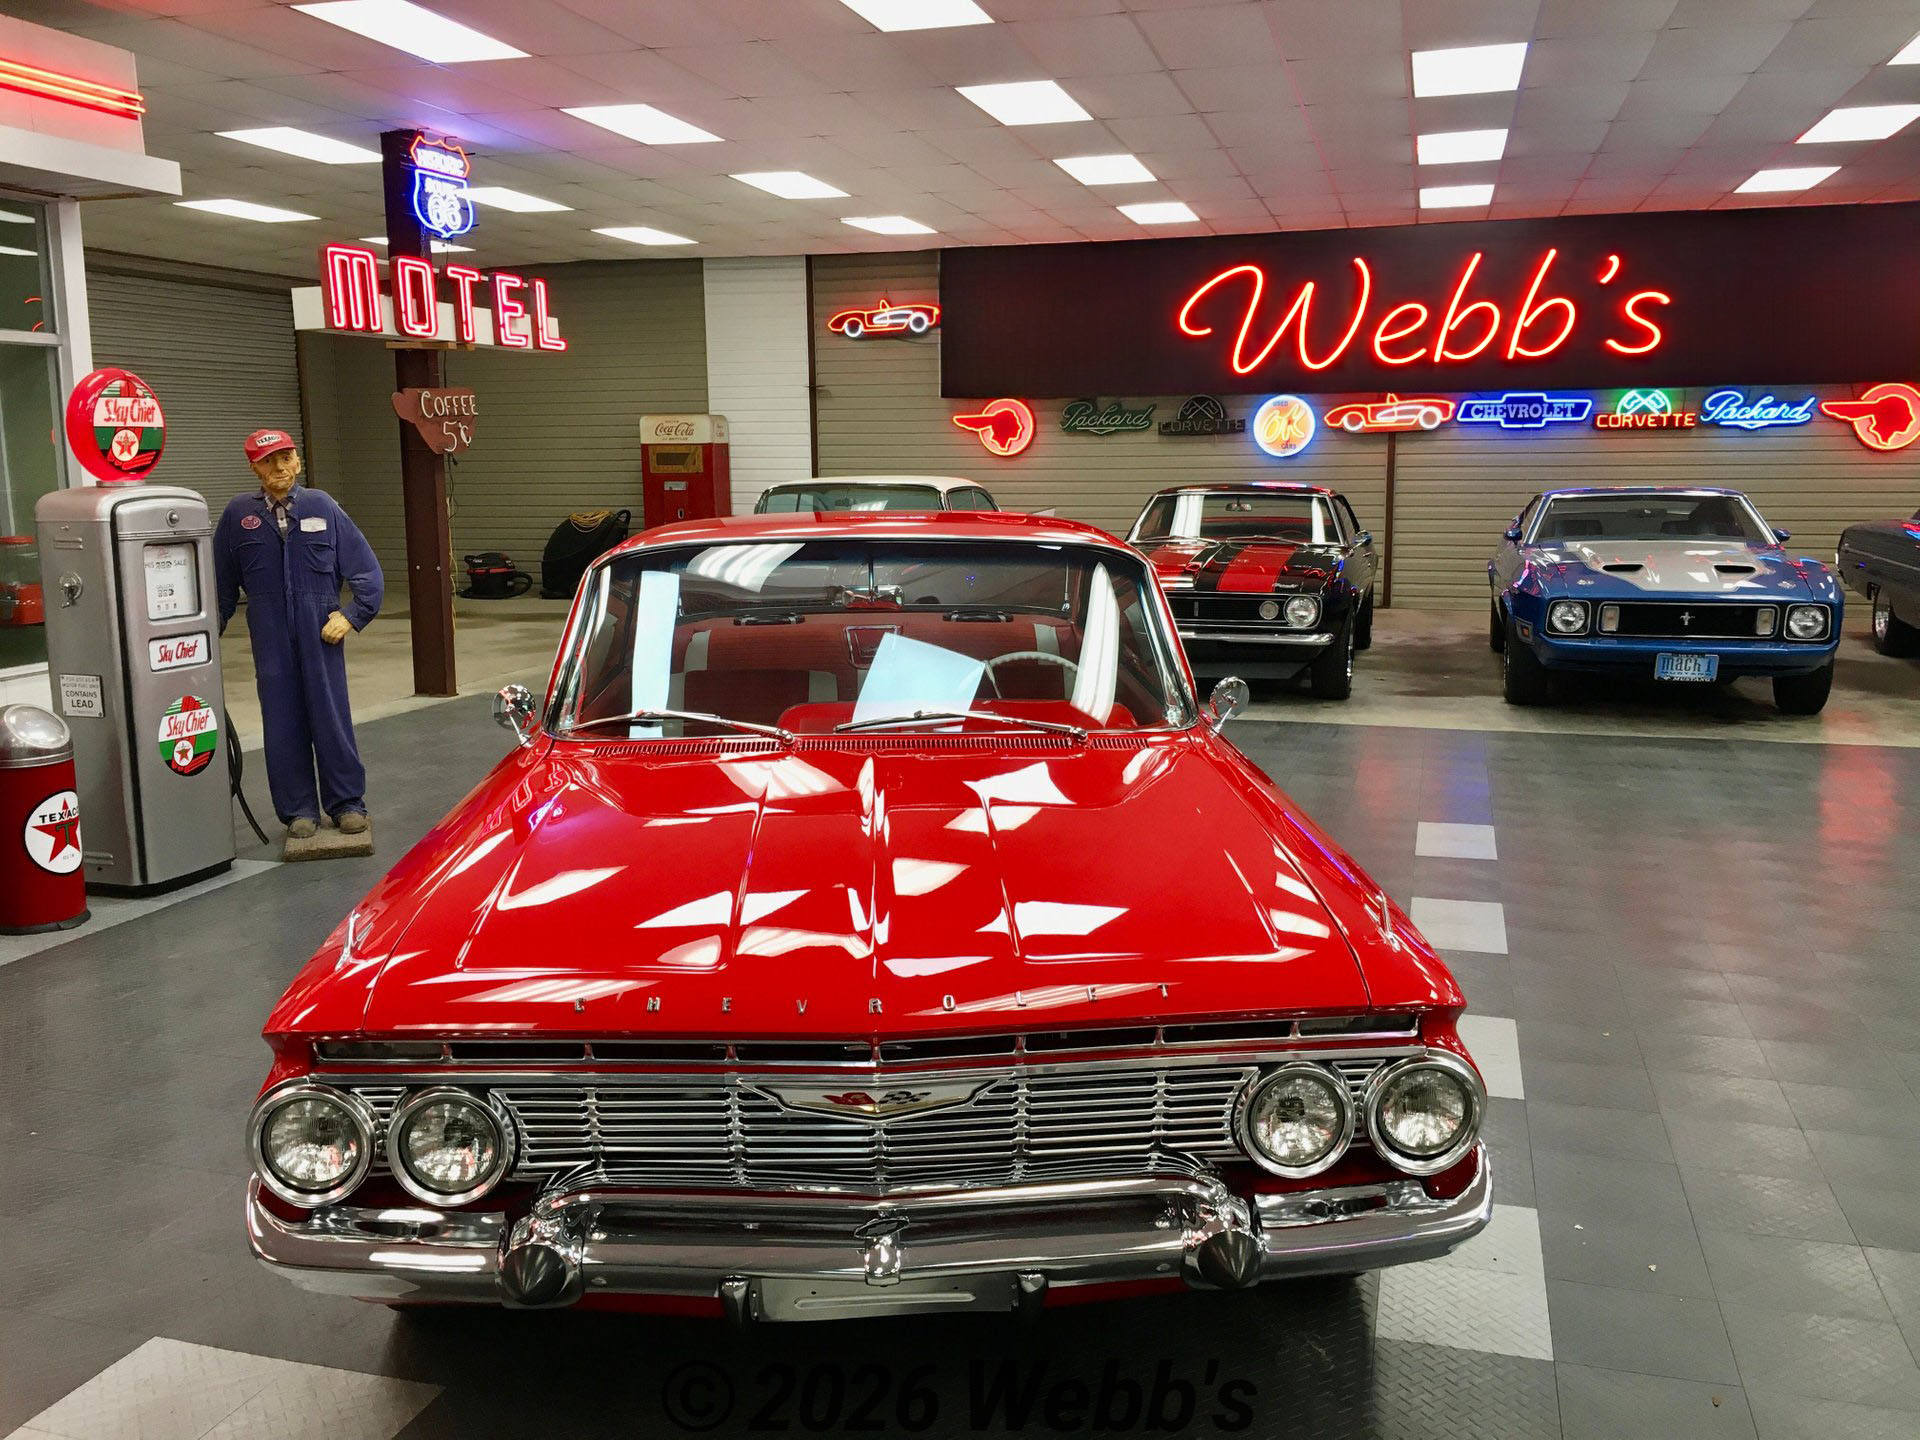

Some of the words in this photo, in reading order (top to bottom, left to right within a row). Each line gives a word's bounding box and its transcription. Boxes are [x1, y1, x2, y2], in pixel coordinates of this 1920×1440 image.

[428, 192, 462, 230] 66
[322, 244, 568, 351] MOTEL
[1179, 247, 1671, 374] Webb's
[104, 399, 128, 425] Sky
[130, 399, 155, 423] Chief
[421, 391, 479, 418] COFFEE
[1059, 401, 1155, 430] Packard
[1470, 403, 1575, 419] CHEVROLET
[1701, 390, 1815, 424] Packard
[1160, 418, 1244, 433] CORVETTE
[1264, 403, 1306, 443] OK
[1596, 413, 1696, 428] CORVETTE
[158, 645, 174, 663] Sky
[175, 640, 199, 659] Chief
[65, 690, 98, 698] CONTAINS
[71, 699, 94, 709] LEAD
[166, 716, 185, 737] Sky
[185, 709, 210, 733] Chief
[574, 984, 1169, 1014] CHEVROLET
